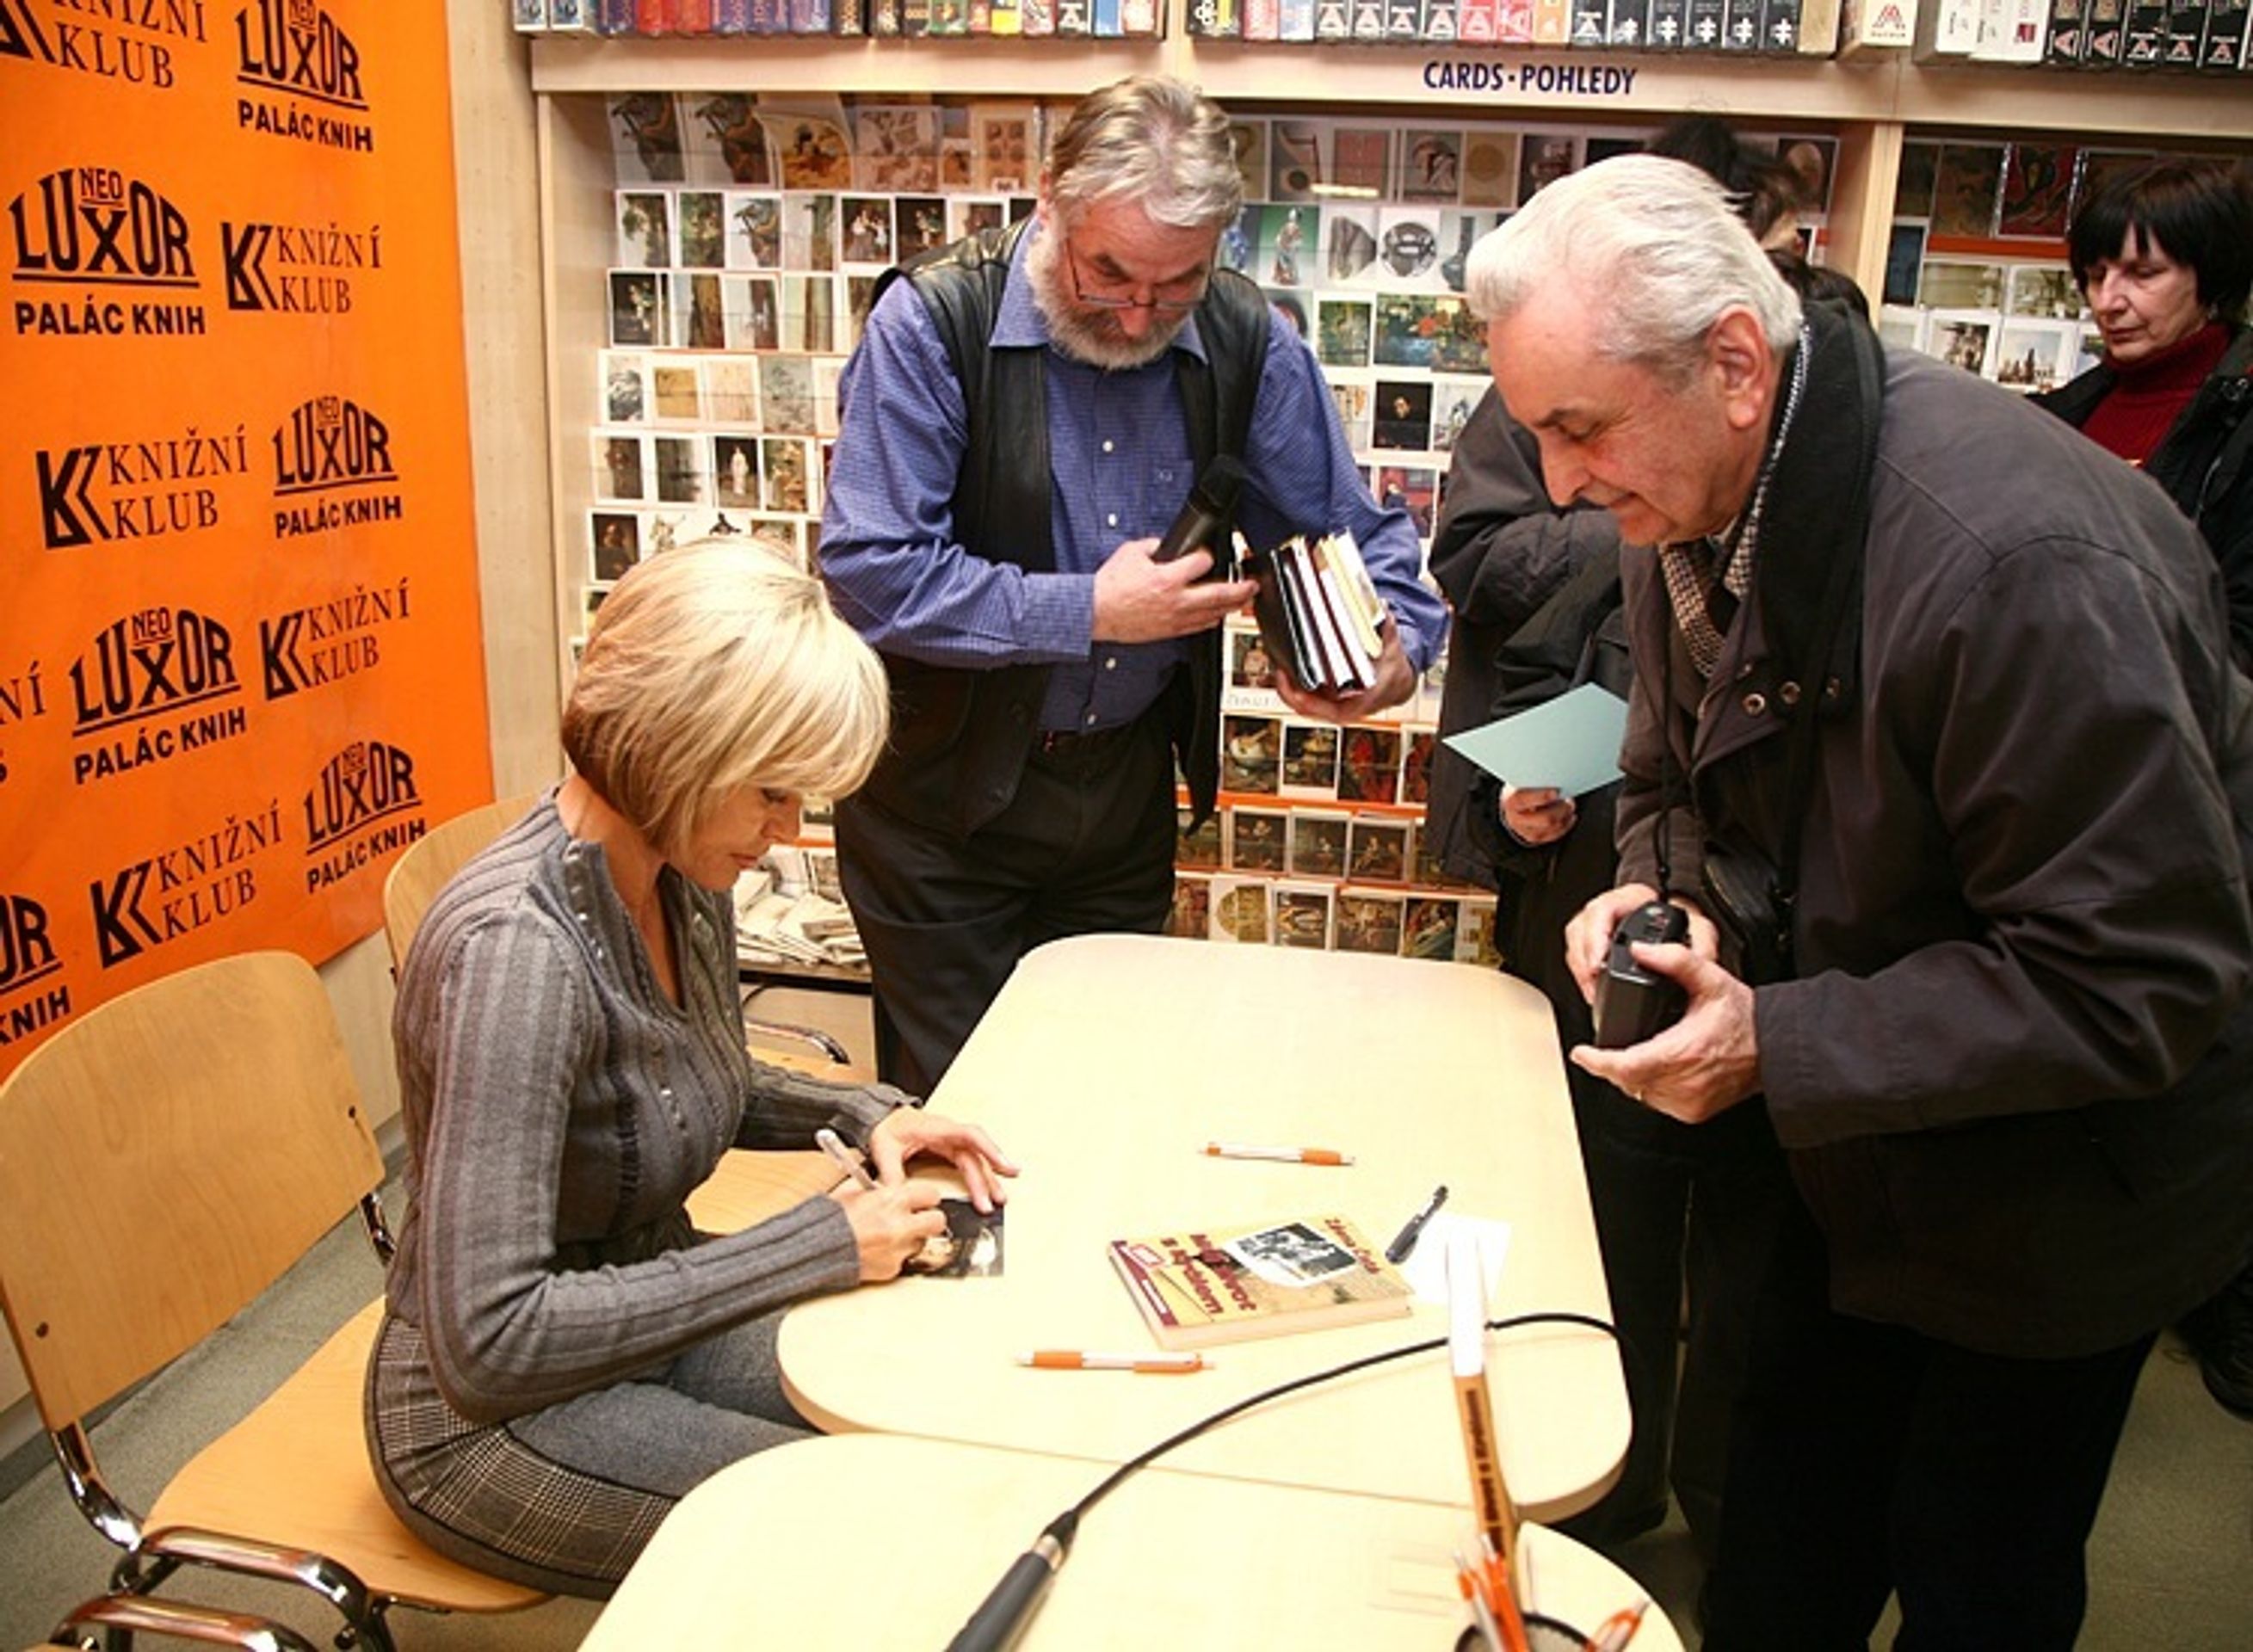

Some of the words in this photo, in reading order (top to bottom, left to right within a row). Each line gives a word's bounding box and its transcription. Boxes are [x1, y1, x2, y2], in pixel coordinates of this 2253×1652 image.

[54, 22, 174, 88] KLUB
[1423, 61, 1503, 91] CARDS
[1520, 64, 1637, 95] POHLEDY
[238, 98, 315, 142] PALÁC
[318, 117, 373, 152] KNIH
[79, 168, 121, 199] NEO
[8, 169, 196, 278] LUXOR
[276, 223, 382, 269] KNIŽNÍ
[15, 295, 124, 335] PALÁC
[133, 305, 205, 335] KNIH
[281, 275, 351, 313] KLUB
[107, 424, 248, 485] KNIŽNÍ
[272, 398, 392, 485] LUXOR
[112, 489, 219, 539] KLUB
[275, 498, 341, 539] PALÁC
[343, 496, 403, 526] KNIH
[133, 607, 171, 639] NEO
[306, 577, 410, 643] KNIŽNÍ
[69, 609, 237, 725] LUXOR
[312, 635, 380, 687] KLUB
[74, 728, 174, 784] PALÁC
[180, 706, 246, 753] KNIH
[304, 742, 417, 844] LUXOR
[157, 798, 281, 894] KNIŽNÍ
[306, 842, 369, 894] PALÁC
[369, 818, 426, 858] KNIH
[162, 866, 257, 942] KLUB
